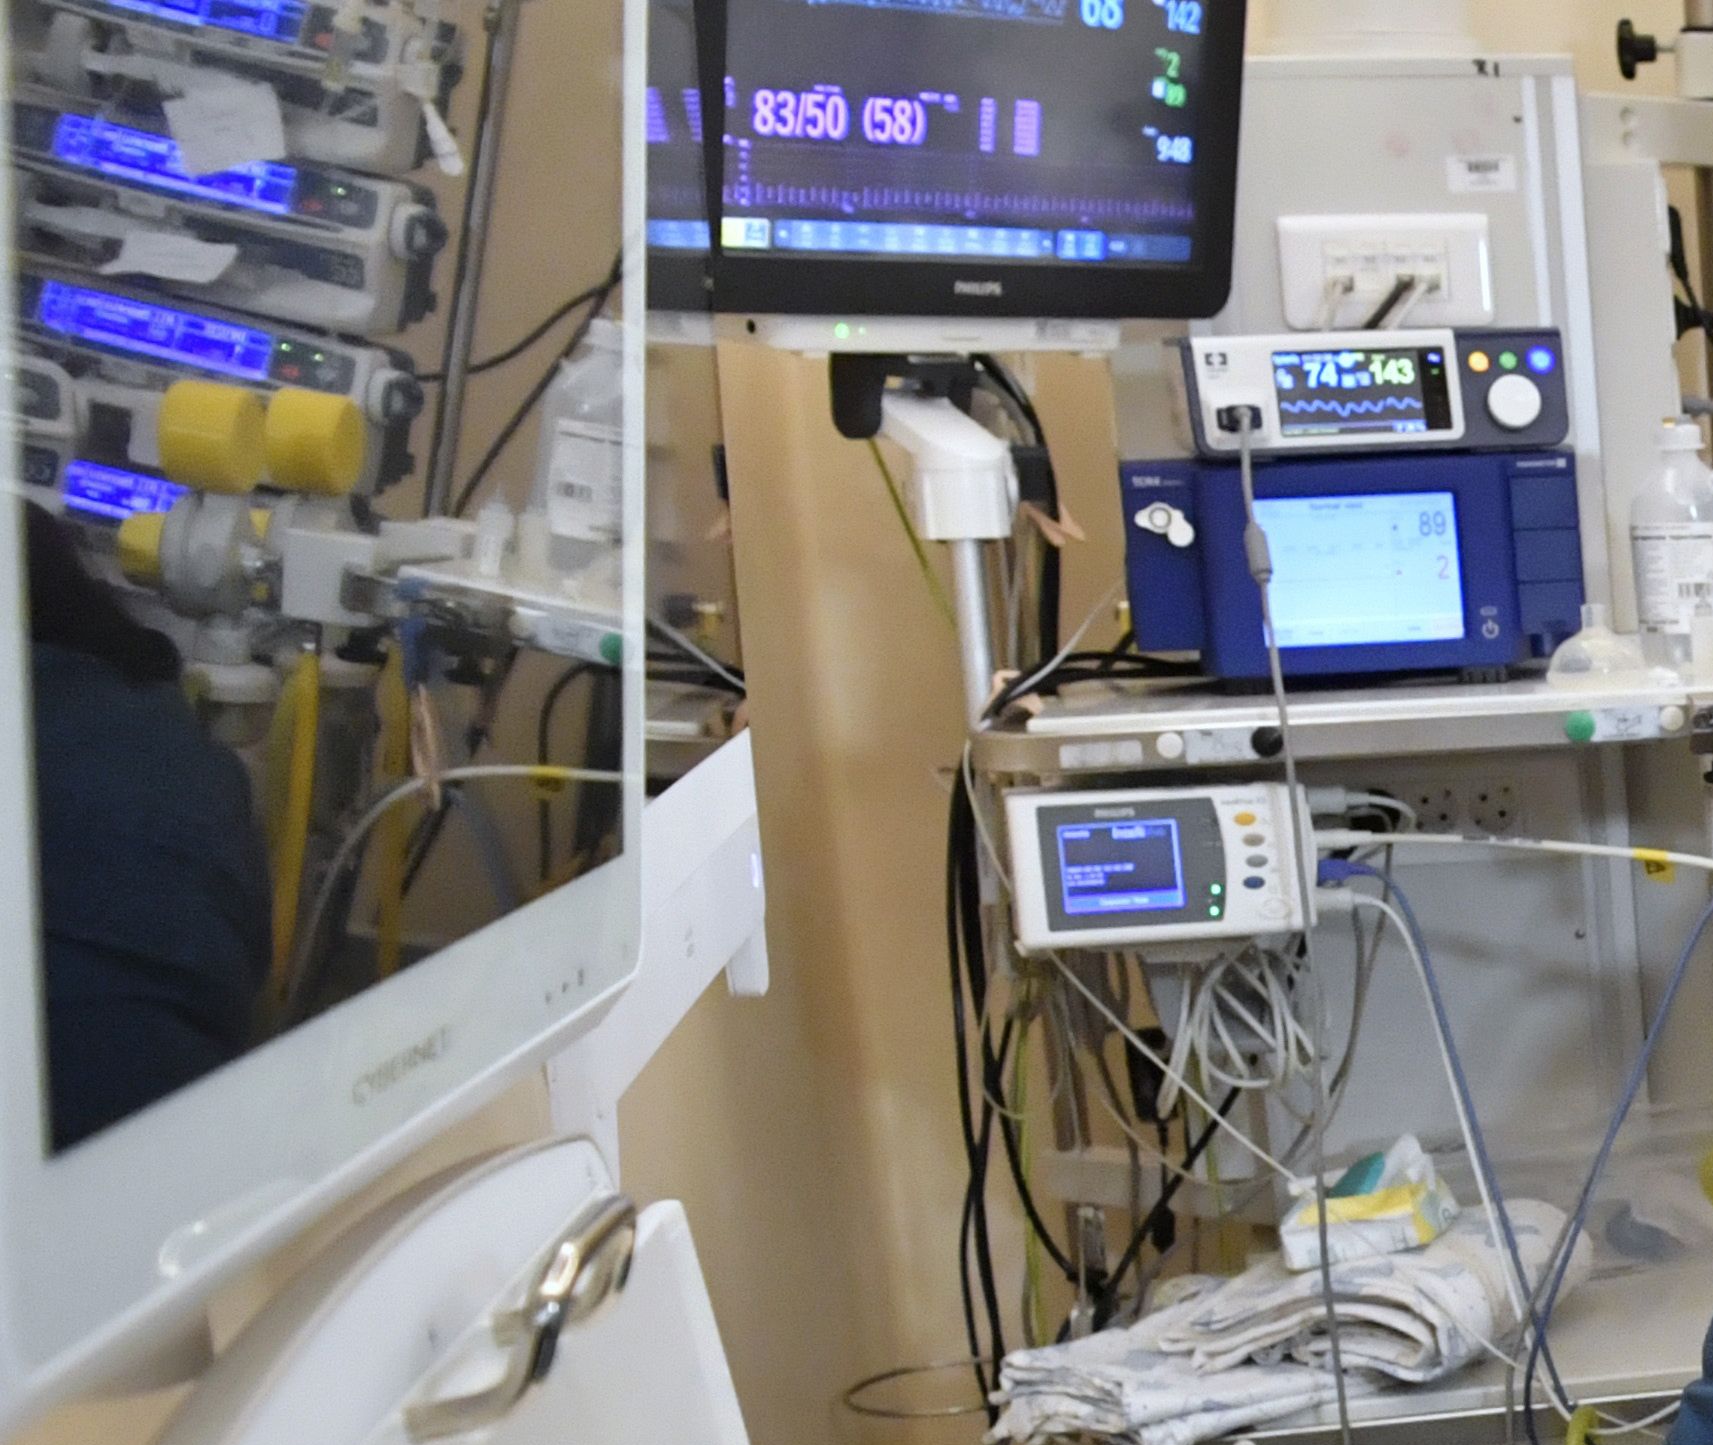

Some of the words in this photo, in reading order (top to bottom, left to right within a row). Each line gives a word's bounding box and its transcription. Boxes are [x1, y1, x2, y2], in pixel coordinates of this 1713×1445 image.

[753, 88, 849, 141] 83/50
[862, 96, 927, 146] (58)
[1303, 361, 1339, 389] 74
[1369, 358, 1416, 385] 143
[1417, 510, 1448, 537] 89
[1437, 555, 1450, 580] 2
